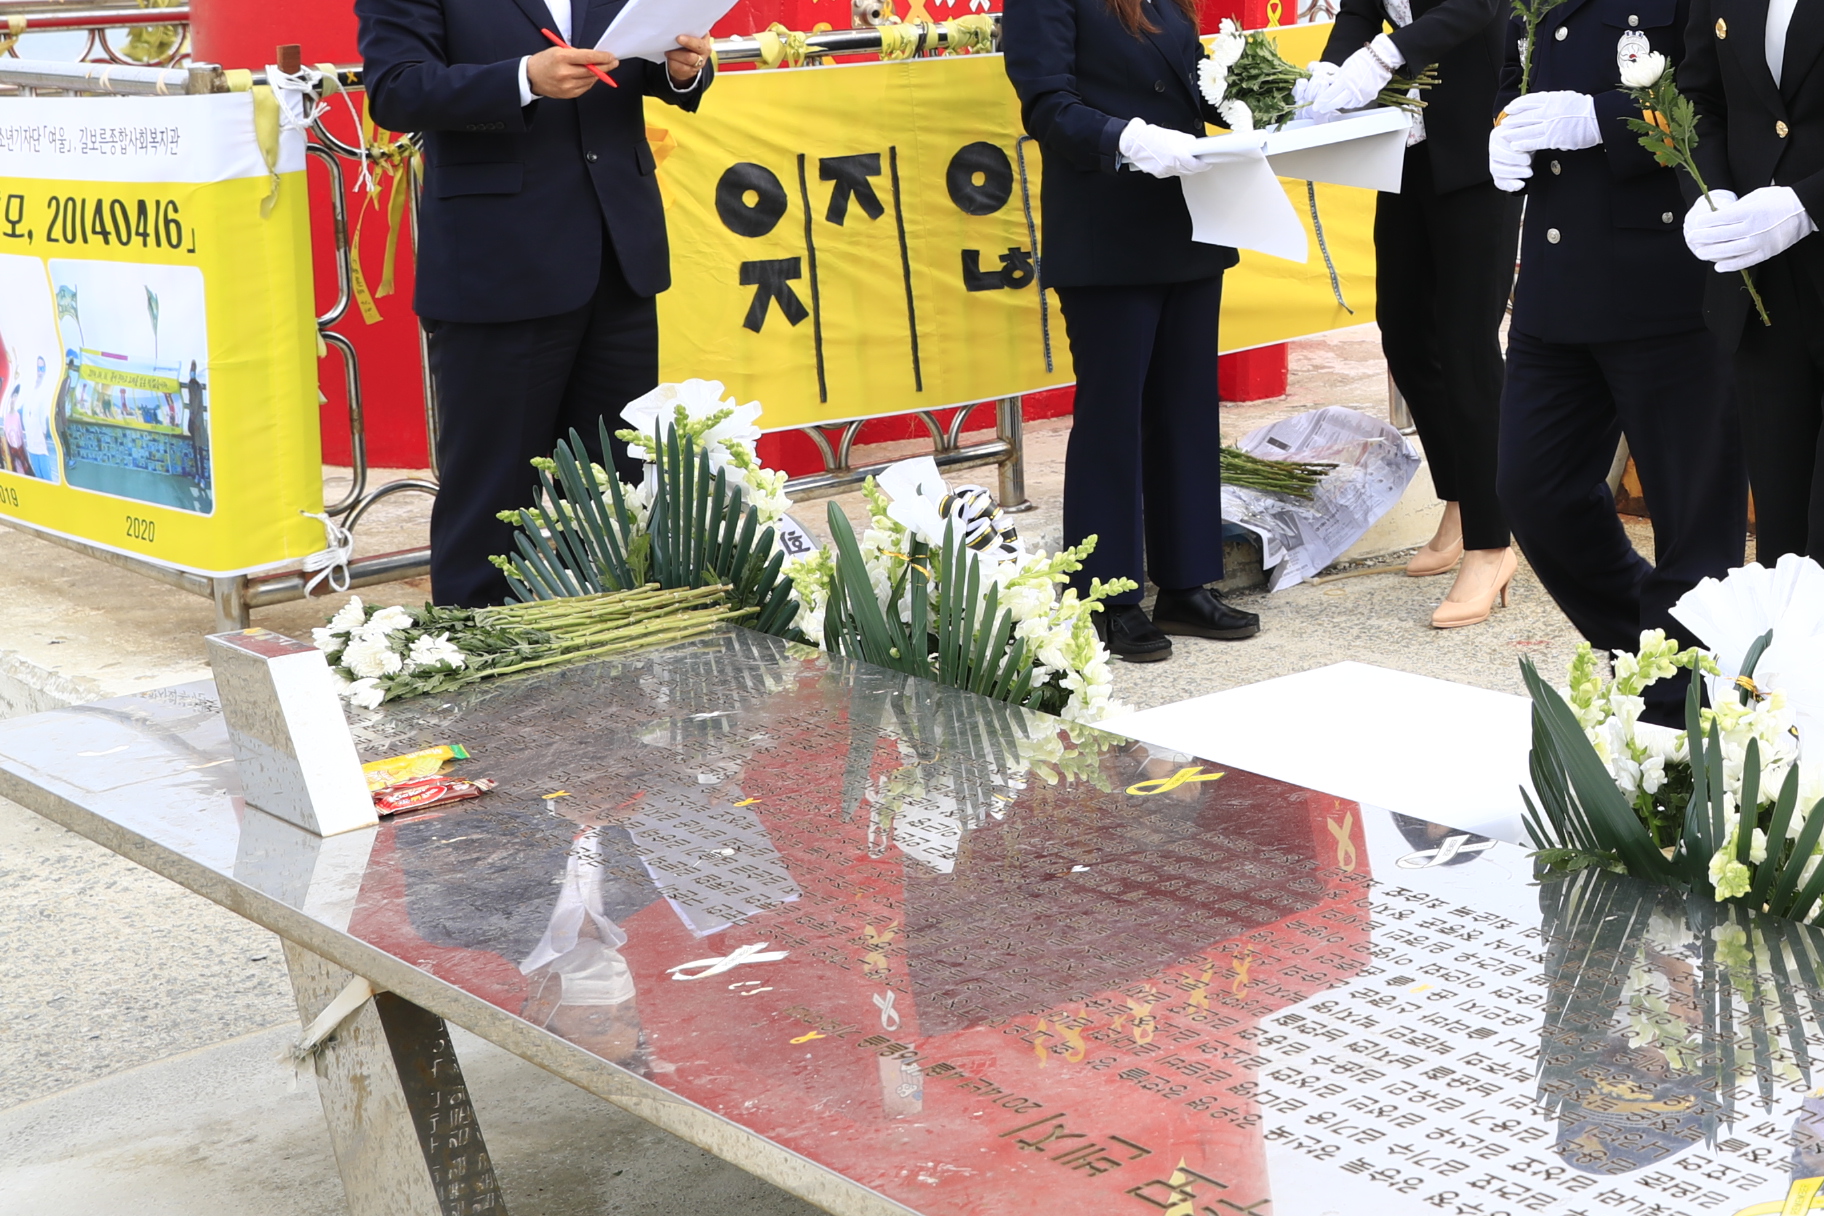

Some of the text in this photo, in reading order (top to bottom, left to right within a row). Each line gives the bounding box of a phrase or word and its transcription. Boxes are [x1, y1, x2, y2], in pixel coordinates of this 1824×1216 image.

[79, 126, 180, 156] 길보른종합사회복지관
[0, 194, 33, 246] 모,
[0, 486, 19, 507] 019
[126, 516, 156, 543] 2020
[1279, 917, 1352, 943] 이영숙
[1379, 927, 1455, 954] 임경빈
[1343, 938, 1422, 966] 이영만
[1449, 949, 1528, 977] 임건우
[1239, 975, 1314, 1004] 박지우
[1275, 963, 1351, 991] 신승희
[1413, 961, 1493, 989] 이연화
[1164, 1000, 1241, 1030] 김인호
[1306, 999, 1386, 1029] 박지영
[1344, 986, 1423, 1016] 신경순
[1452, 998, 1535, 1028] 윤민지
[1487, 984, 1569, 1014] 이승현
[1085, 1026, 1162, 1057] 김대현
[1125, 1013, 1201, 1043] 김소정
[1269, 1012, 1350, 1042] 남현철
[1379, 1024, 1462, 1055] 박준민
[1414, 1010, 1499, 1041] 슬라바
[852, 1033, 932, 1067] 16일을
[1192, 1038, 1272, 1070] 김소연
[1341, 1037, 1425, 1069] 남지현
[917, 1061, 971, 1084] 4월
[1112, 1066, 1192, 1099] 강한솔
[1152, 1052, 1233, 1085] 김담비
[1264, 1065, 1348, 1099] 김성현
[1304, 1051, 1388, 1084] 김윤수
[1417, 1064, 1505, 1098] 남윤철
[1455, 1050, 1541, 1083] 박주희
[953, 1076, 1045, 1116] 2014년
[1183, 1094, 1268, 1129] 강우영
[1224, 1080, 1309, 1114] 김다영
[1339, 1093, 1427, 1129] 김성빈
[1380, 1079, 1467, 1113] 김유민
[992, 1109, 1155, 1180] 벤치
[1259, 1124, 1347, 1161] 강신욱
[1378, 1139, 1471, 1177] 김기수
[1420, 1124, 1511, 1160] 김선우
[1337, 1155, 1430, 1194] 강승묵
[1502, 1155, 1599, 1194] 김상호
[1671, 1152, 1769, 1191] 김호연
[1462, 1171, 1559, 1211] 김건호
[1631, 1170, 1731, 1210] 김완준
